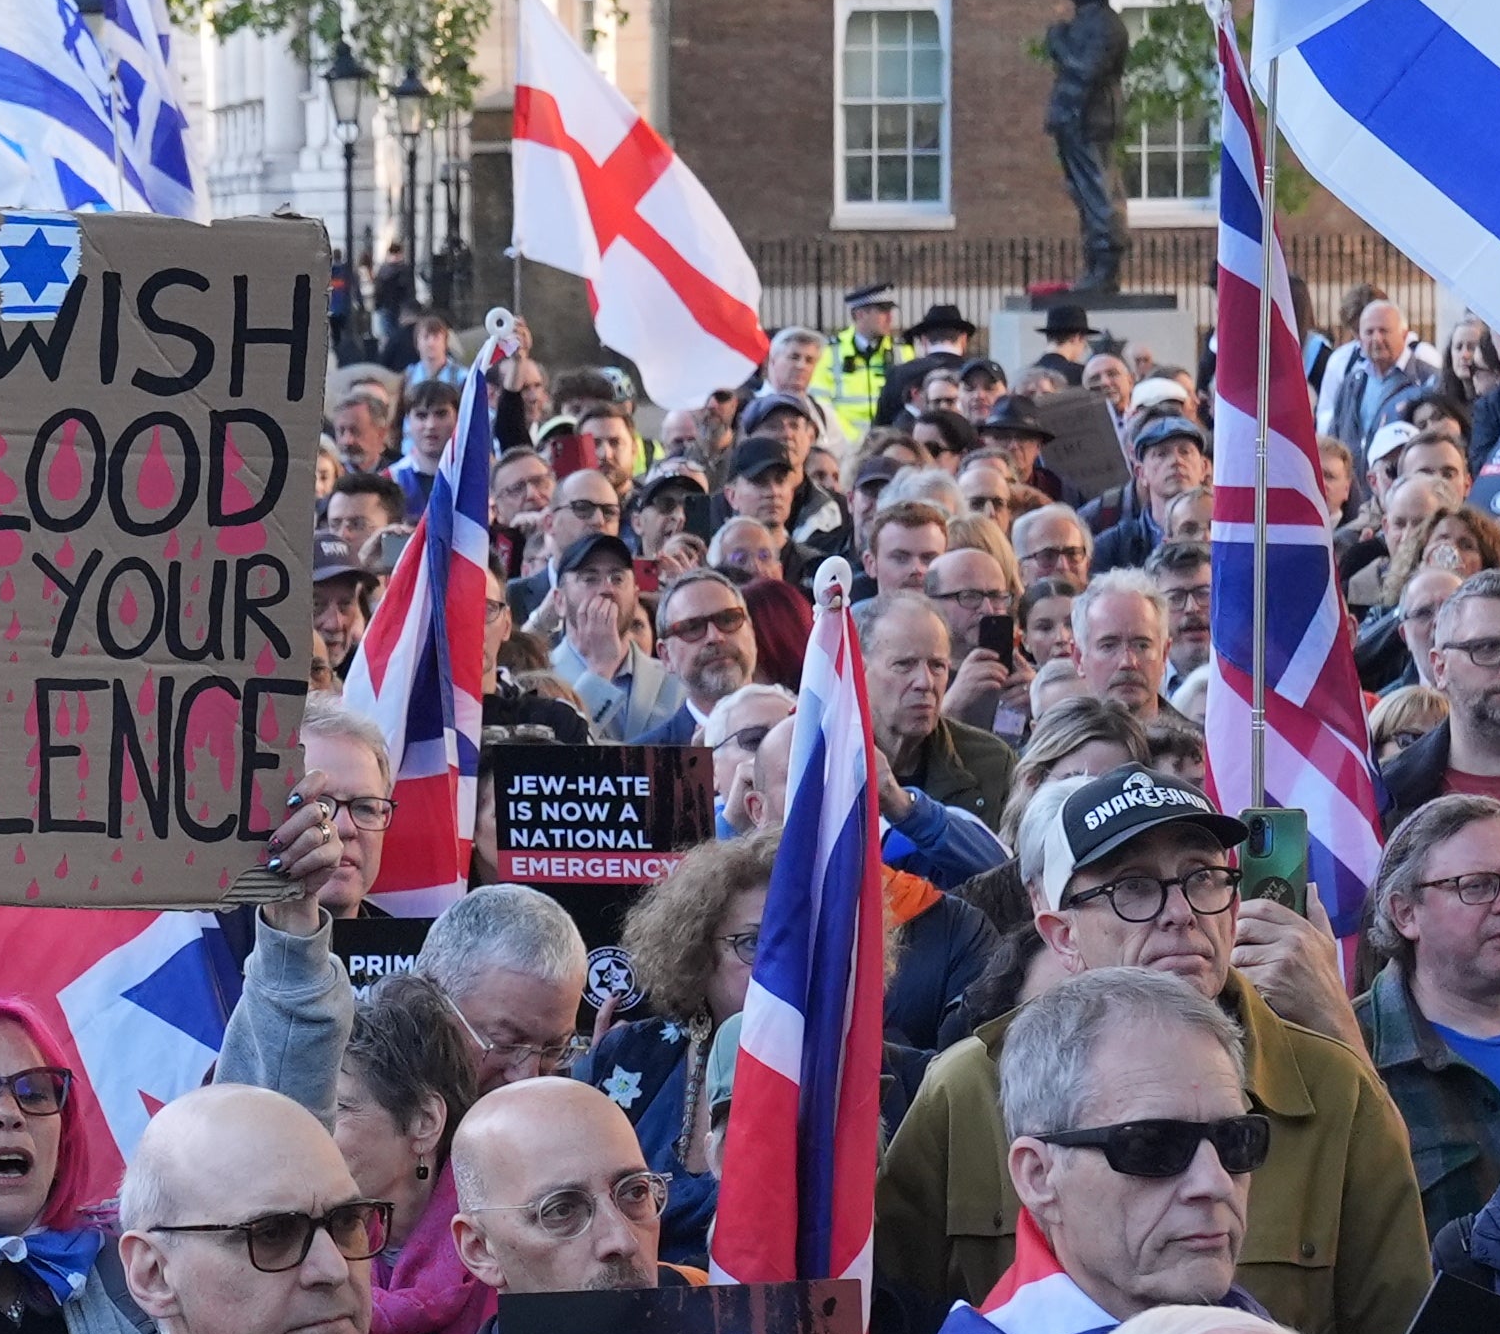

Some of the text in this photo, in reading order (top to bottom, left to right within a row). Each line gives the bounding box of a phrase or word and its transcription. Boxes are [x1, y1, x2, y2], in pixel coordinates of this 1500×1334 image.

[31, 548, 292, 662] YOUR
[507, 775, 651, 799] JEW-HATE
[508, 801, 639, 823] IS NOW A
[509, 827, 653, 850] NATIONAL
[349, 954, 420, 977] PRIM
